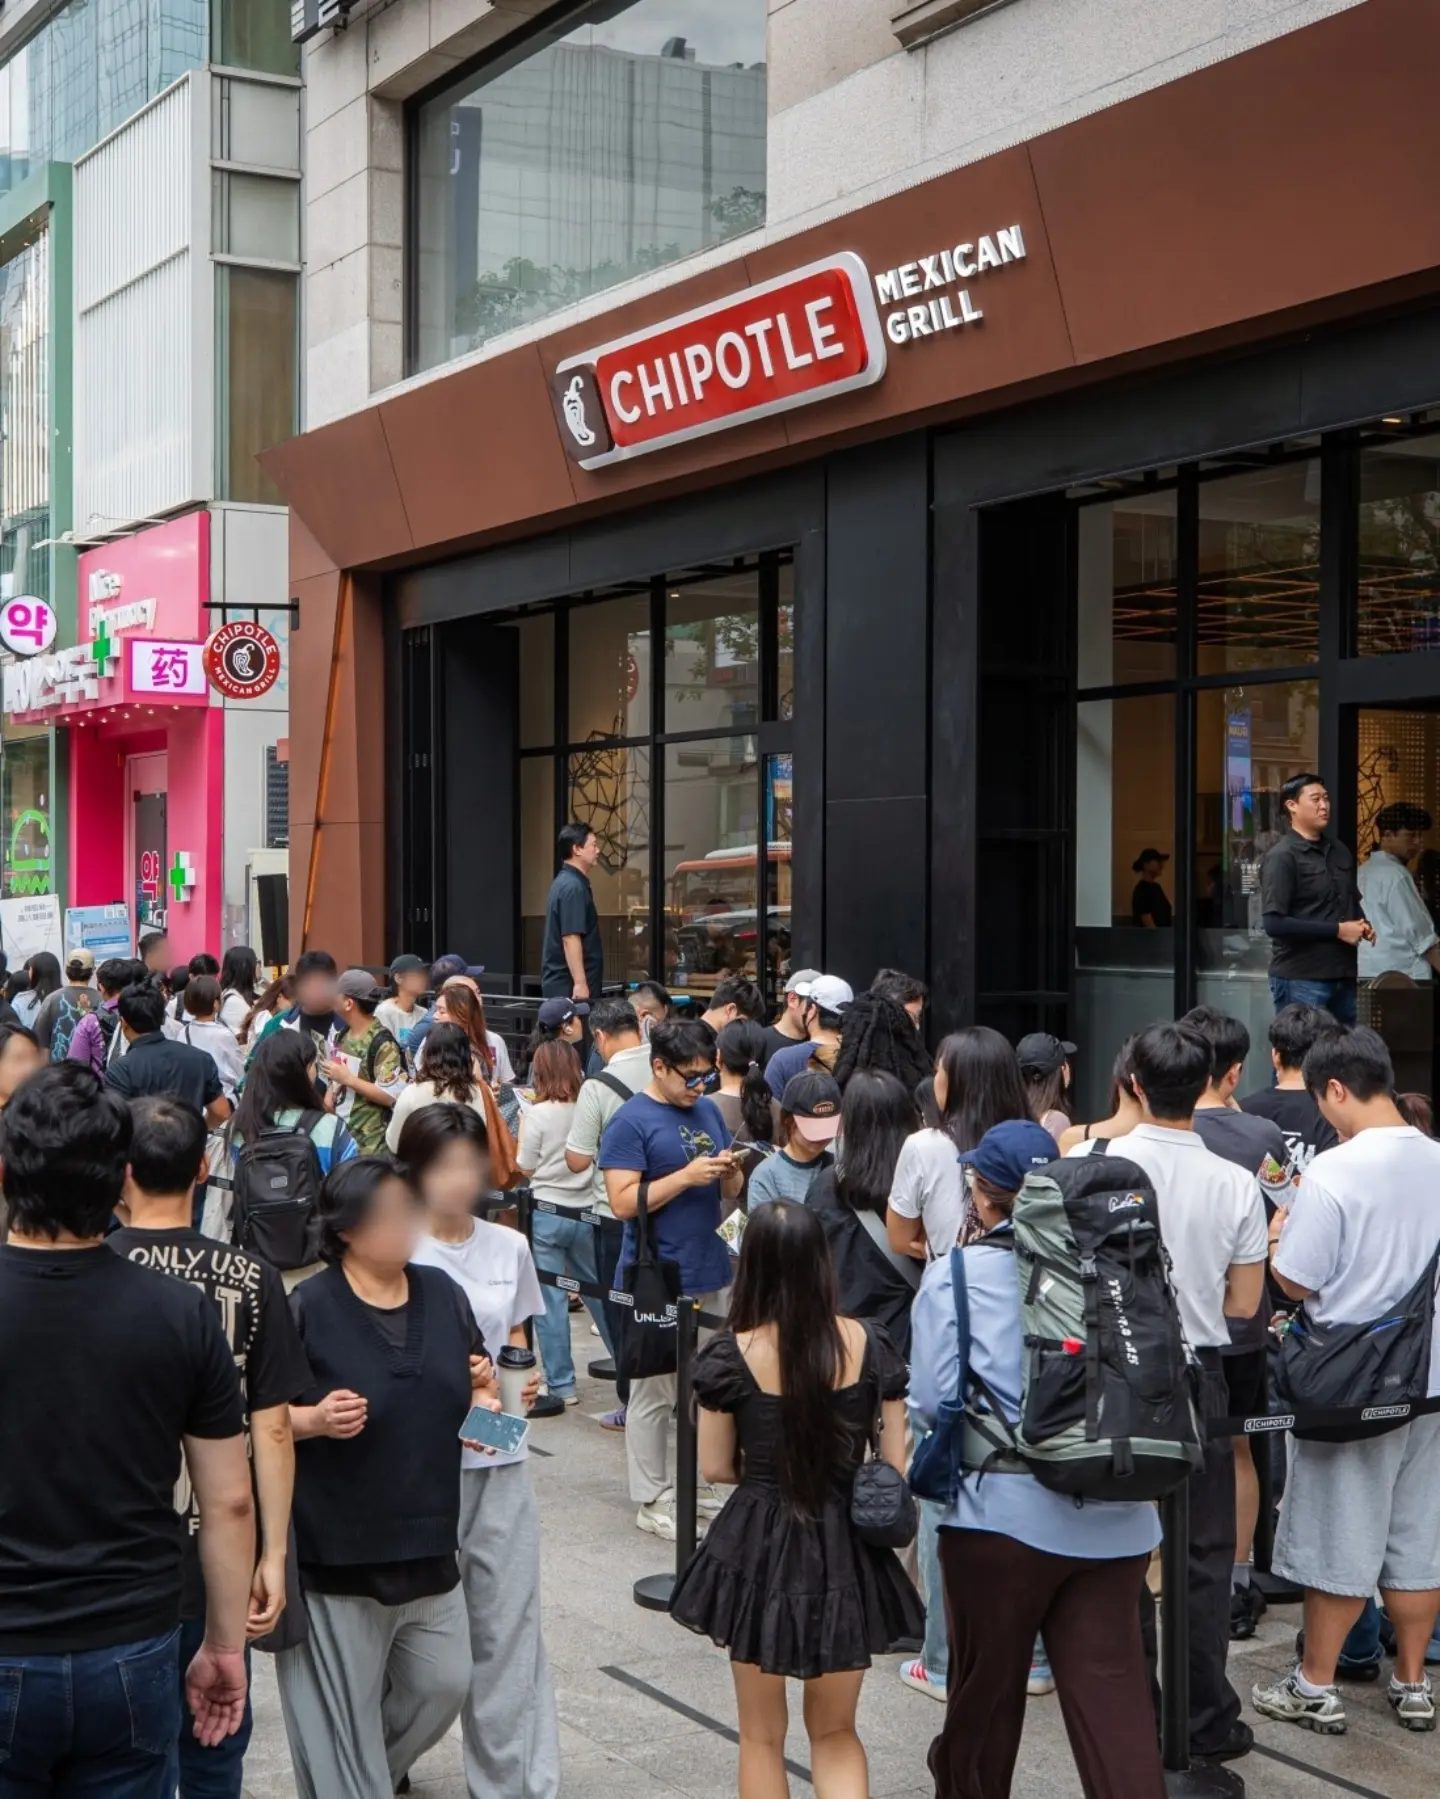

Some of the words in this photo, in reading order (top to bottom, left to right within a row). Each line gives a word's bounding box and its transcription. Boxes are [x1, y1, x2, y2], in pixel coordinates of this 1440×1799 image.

[875, 224, 1025, 305] MEXICAN
[886, 290, 983, 345] GRILL
[610, 296, 844, 424] CHIPOTLE
[7, 603, 48, 647] 약
[213, 624, 276, 656] CHIPOTLE
[151, 647, 189, 688] 药
[214, 666, 253, 695] MEXICAN
[254, 667, 276, 693] GRILL
[140, 850, 160, 903] 약
[128, 1245, 206, 1271] ONLY
[211, 1250, 262, 1290] USE
[1255, 1417, 1292, 1429] CHIPOTLE
[1372, 1405, 1408, 1417] CHIPOTLE
